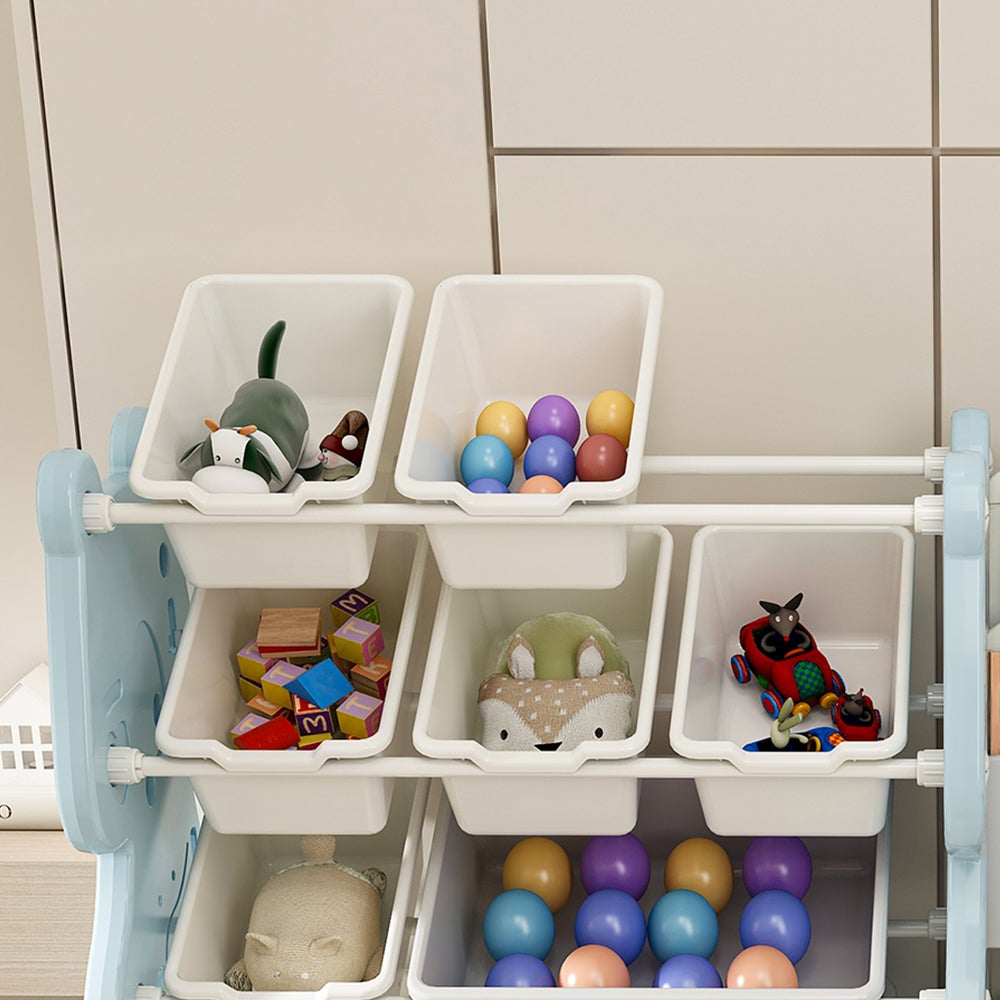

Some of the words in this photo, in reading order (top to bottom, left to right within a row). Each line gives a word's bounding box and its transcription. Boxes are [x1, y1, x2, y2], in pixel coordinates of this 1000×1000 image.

[342, 621, 372, 637] T
[344, 695, 374, 711] T
[303, 715, 328, 734] M
